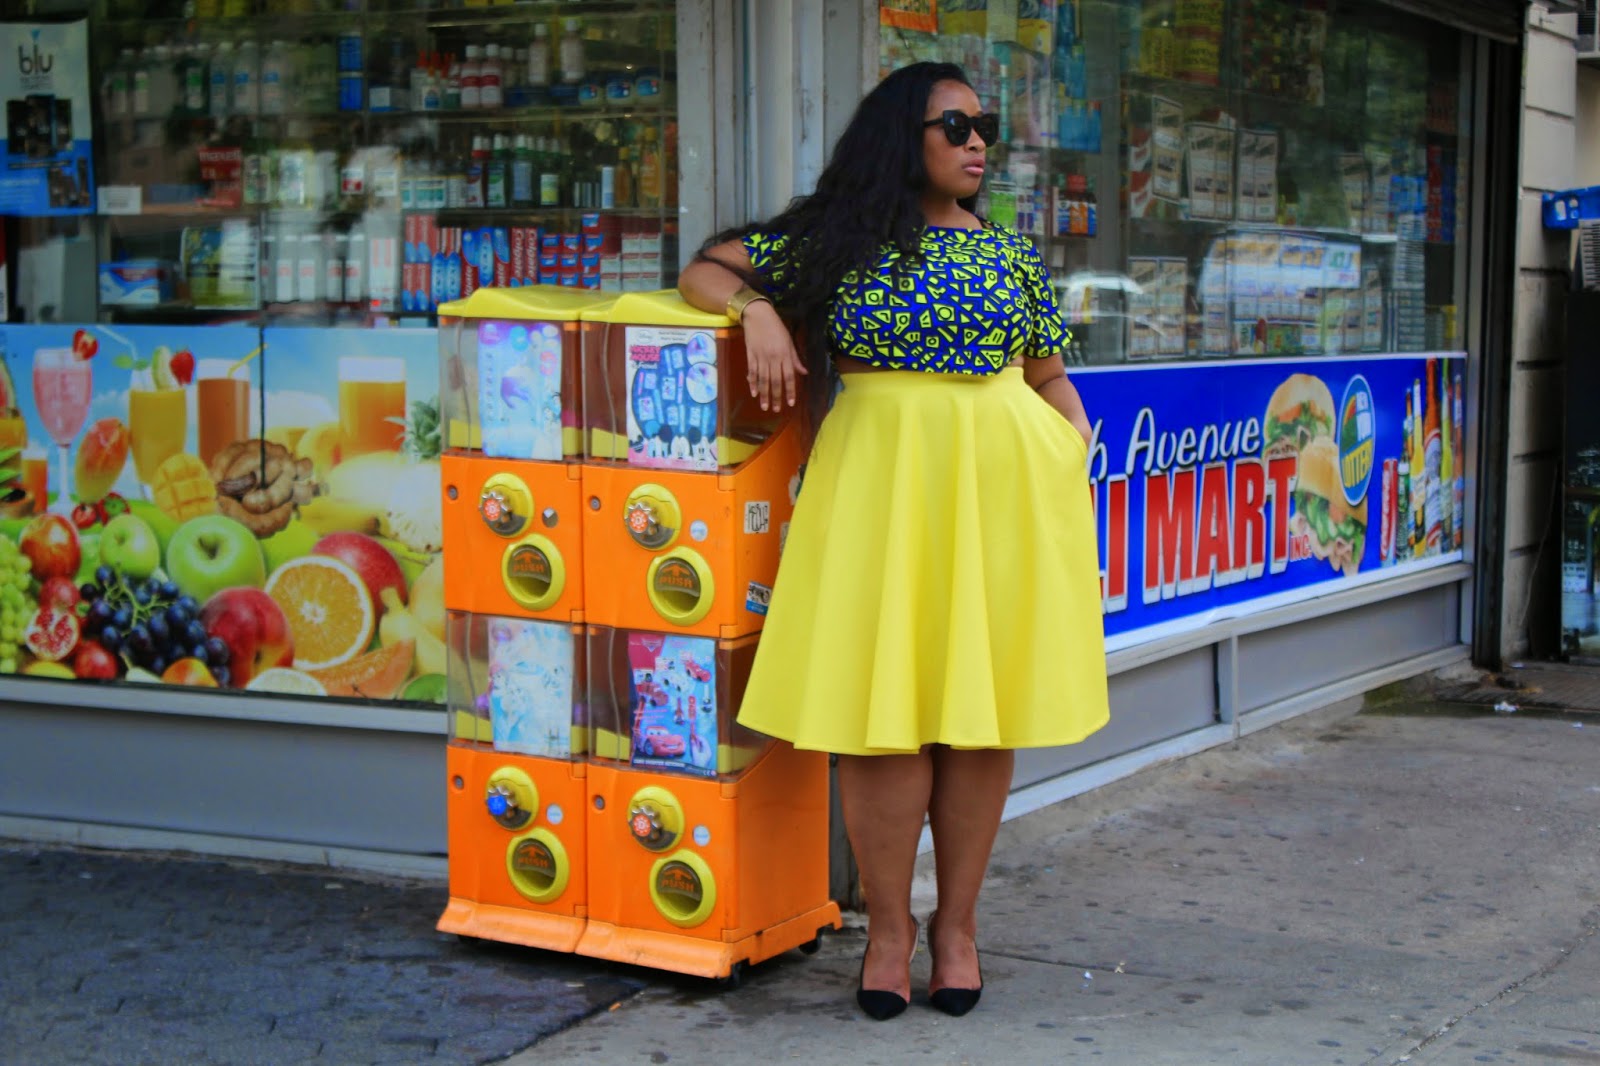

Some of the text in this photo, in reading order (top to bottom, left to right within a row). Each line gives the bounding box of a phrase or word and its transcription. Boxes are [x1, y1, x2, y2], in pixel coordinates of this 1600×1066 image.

[18, 44, 54, 75] blu
[1125, 406, 1260, 475] Avenue
[1143, 453, 1298, 604] MART
[513, 562, 545, 573] PUSH
[659, 575, 693, 588] PUSH
[517, 857, 548, 868] PUSH
[661, 879, 694, 892] PUSH
